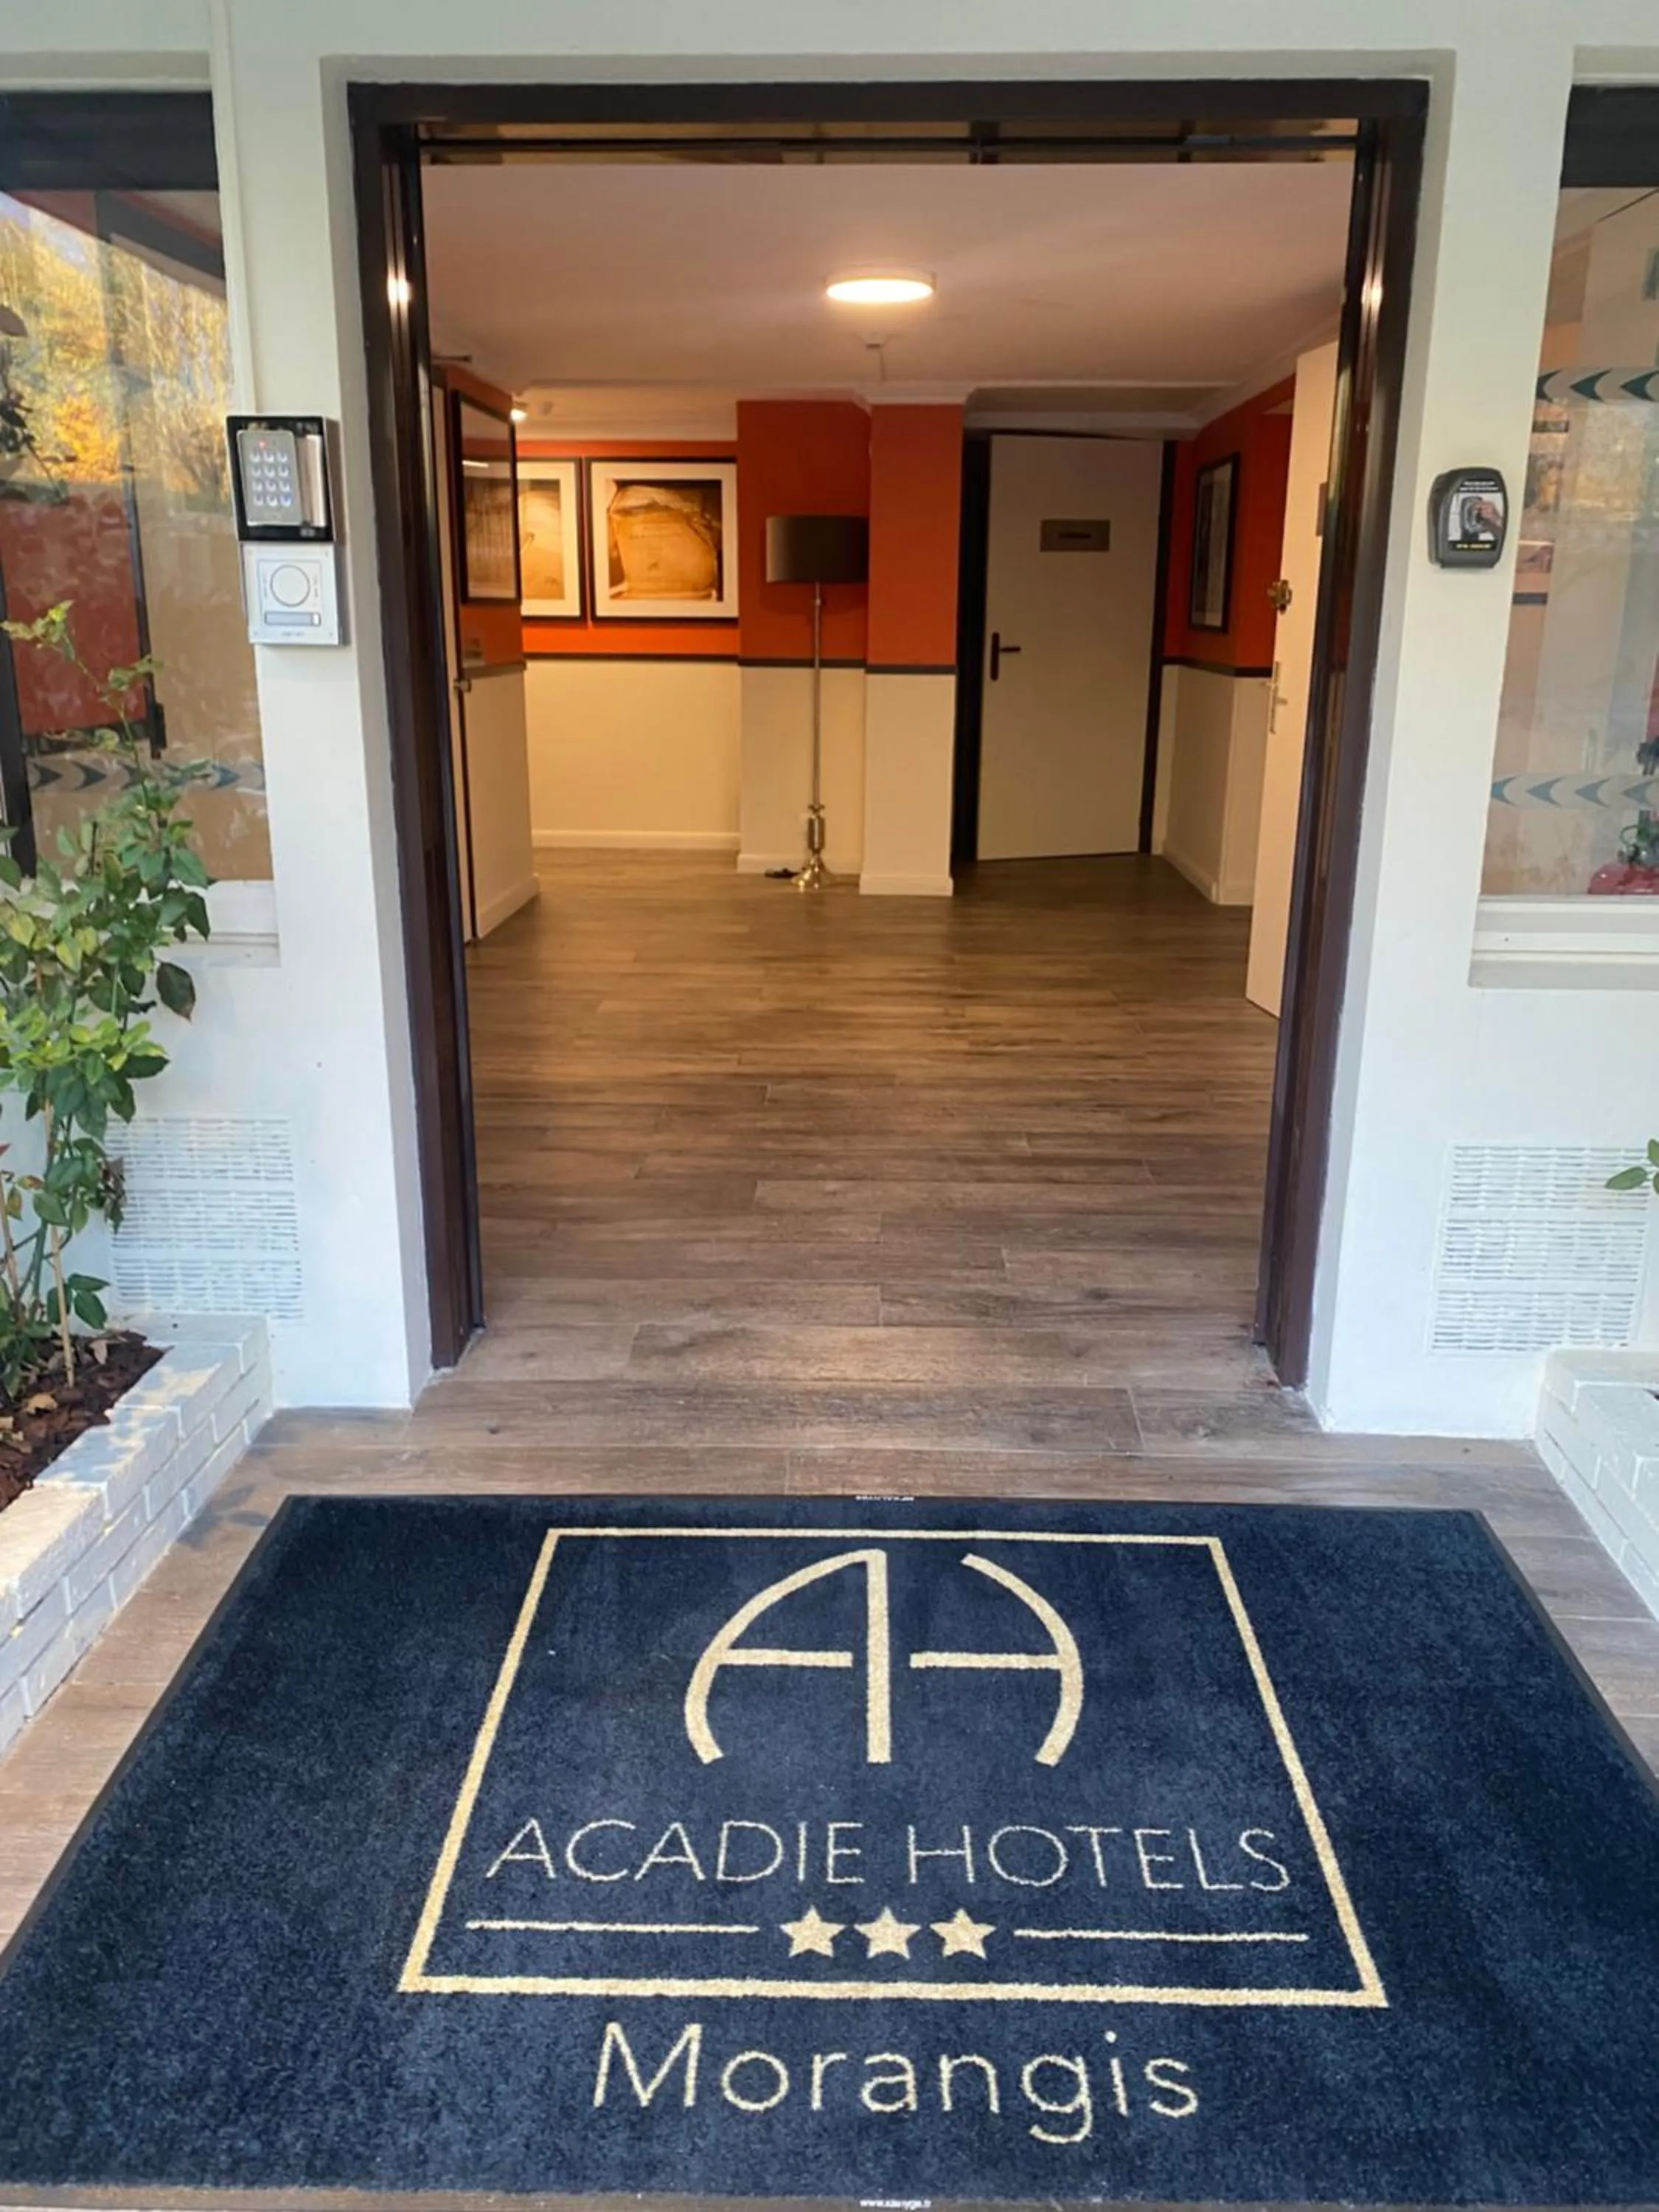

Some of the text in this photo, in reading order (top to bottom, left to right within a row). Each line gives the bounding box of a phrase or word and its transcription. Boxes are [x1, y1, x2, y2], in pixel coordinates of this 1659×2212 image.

[484, 1817, 1292, 1892] ACADIE HOTELS
[592, 2020, 1200, 2145] Morangis
